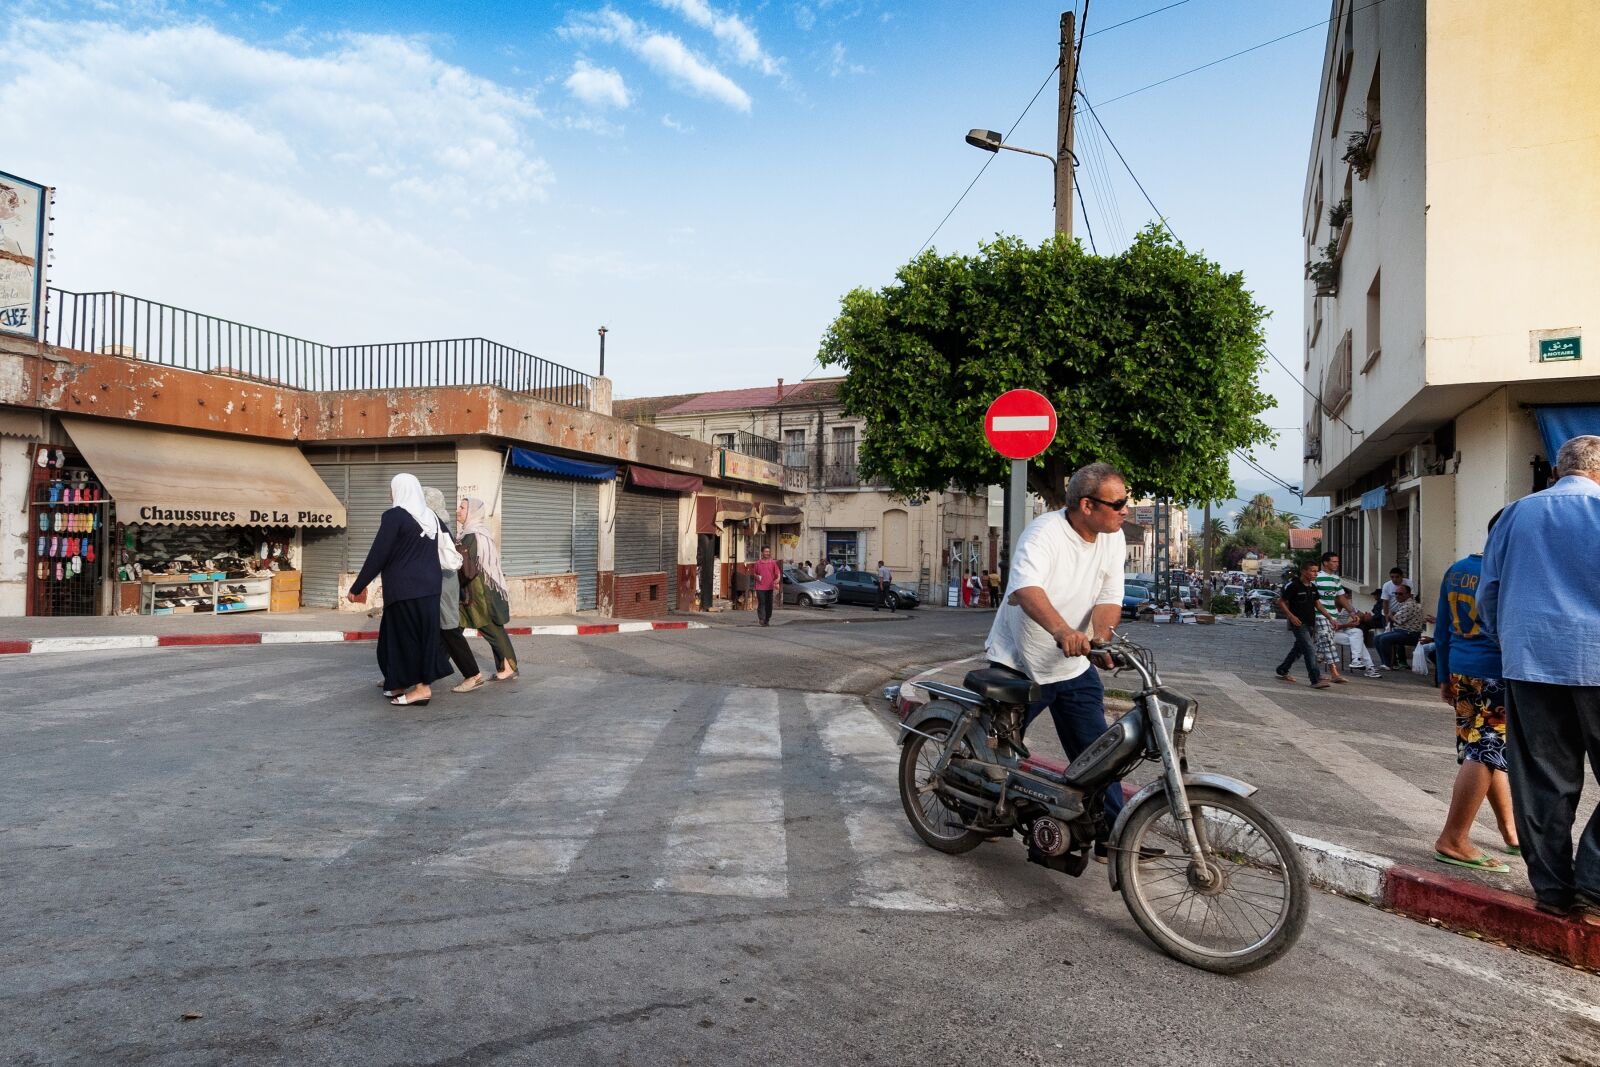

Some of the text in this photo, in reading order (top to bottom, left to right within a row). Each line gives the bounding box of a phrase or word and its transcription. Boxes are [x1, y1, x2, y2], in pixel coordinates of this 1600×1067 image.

[140, 506, 333, 524] Chaussures De La Place
[1013, 783, 1050, 801] PEUGEOT
